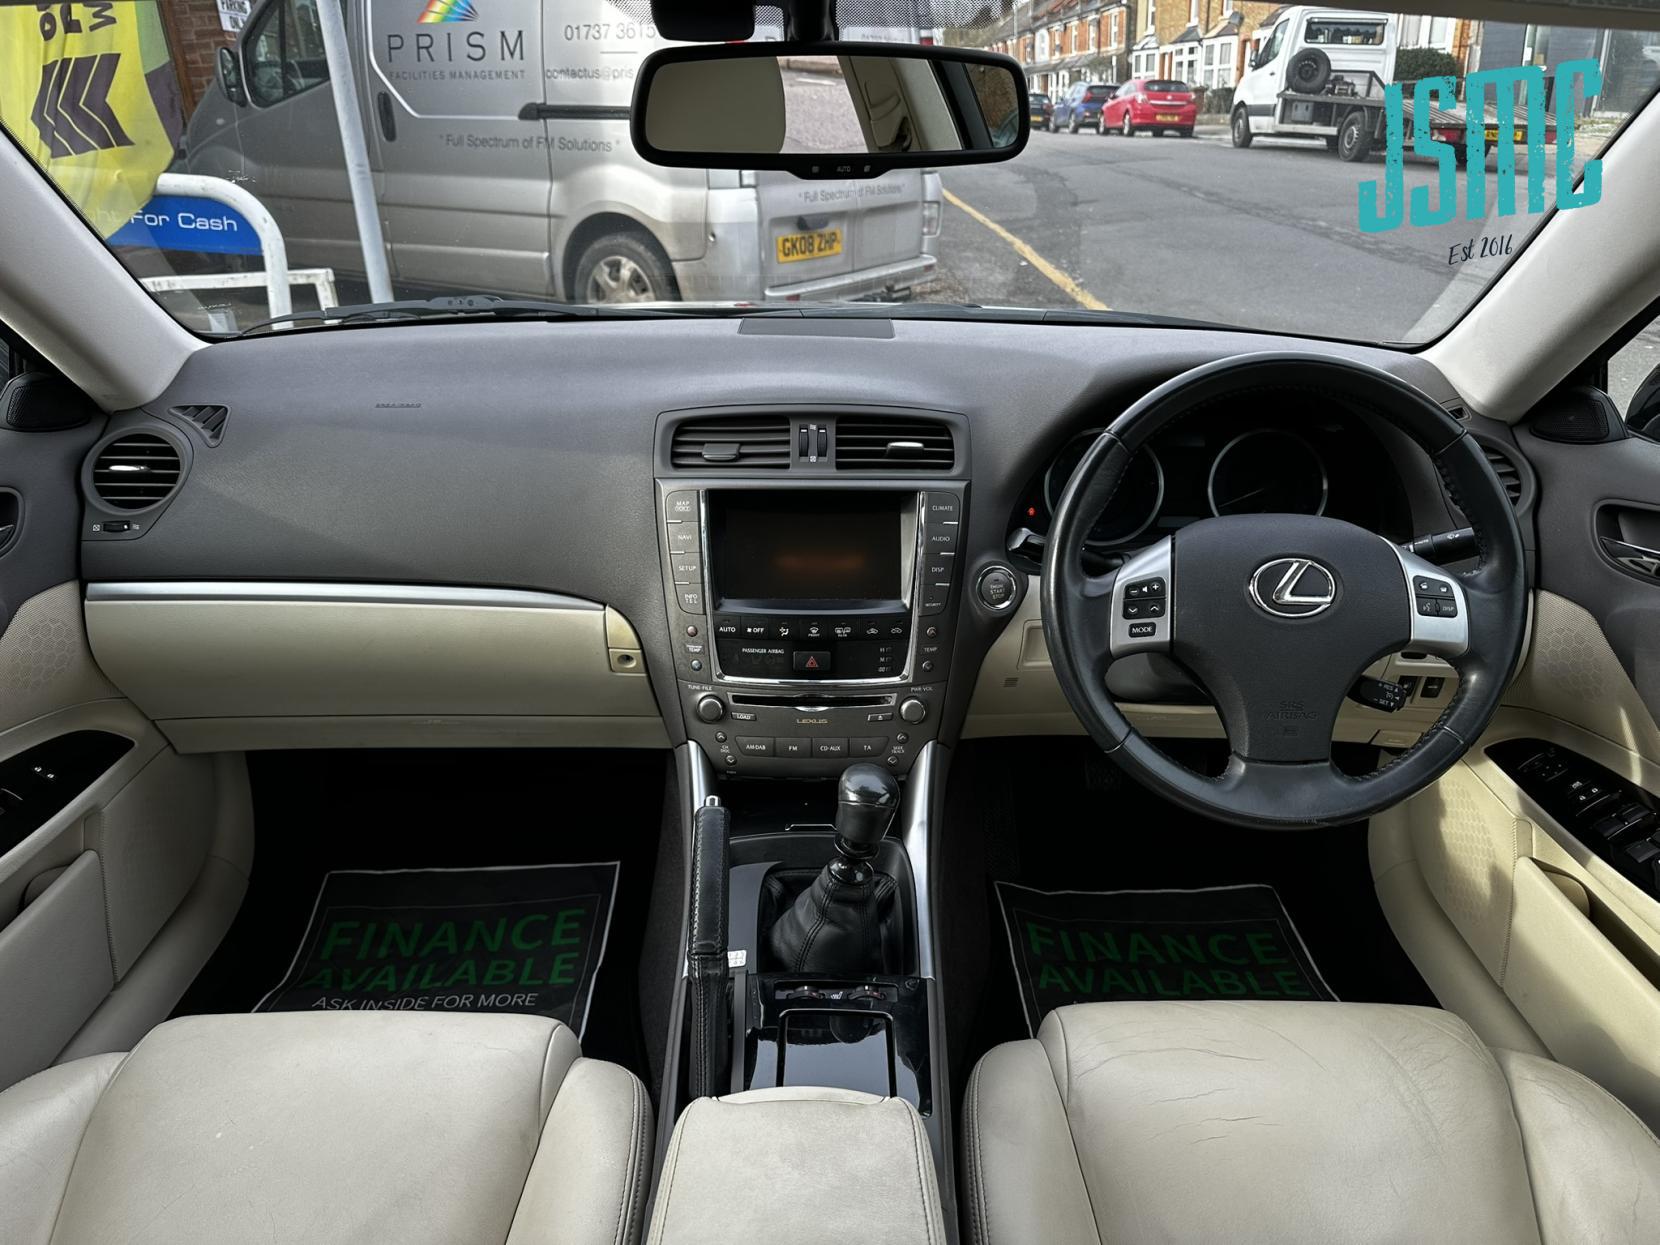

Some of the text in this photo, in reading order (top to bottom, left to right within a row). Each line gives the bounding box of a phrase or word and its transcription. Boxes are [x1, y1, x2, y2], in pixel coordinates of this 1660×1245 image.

[564, 24, 610, 41] 01737
[387, 30, 524, 62] PRISM
[390, 69, 525, 80] FACILITIES MANAGEMENT
[466, 134, 519, 150] Spectrum
[522, 136, 534, 149] of
[131, 209, 170, 226] For
[177, 212, 238, 232] Cash
[782, 231, 838, 257] GK08 ZHP
[320, 908, 586, 960] FINANCE
[1025, 921, 1289, 965] FINANCE
[300, 952, 579, 992] AVAILABLE
[1038, 964, 1311, 997] AVAILABLE
[312, 993, 538, 1011] ASK INSIDE FOR MORE
